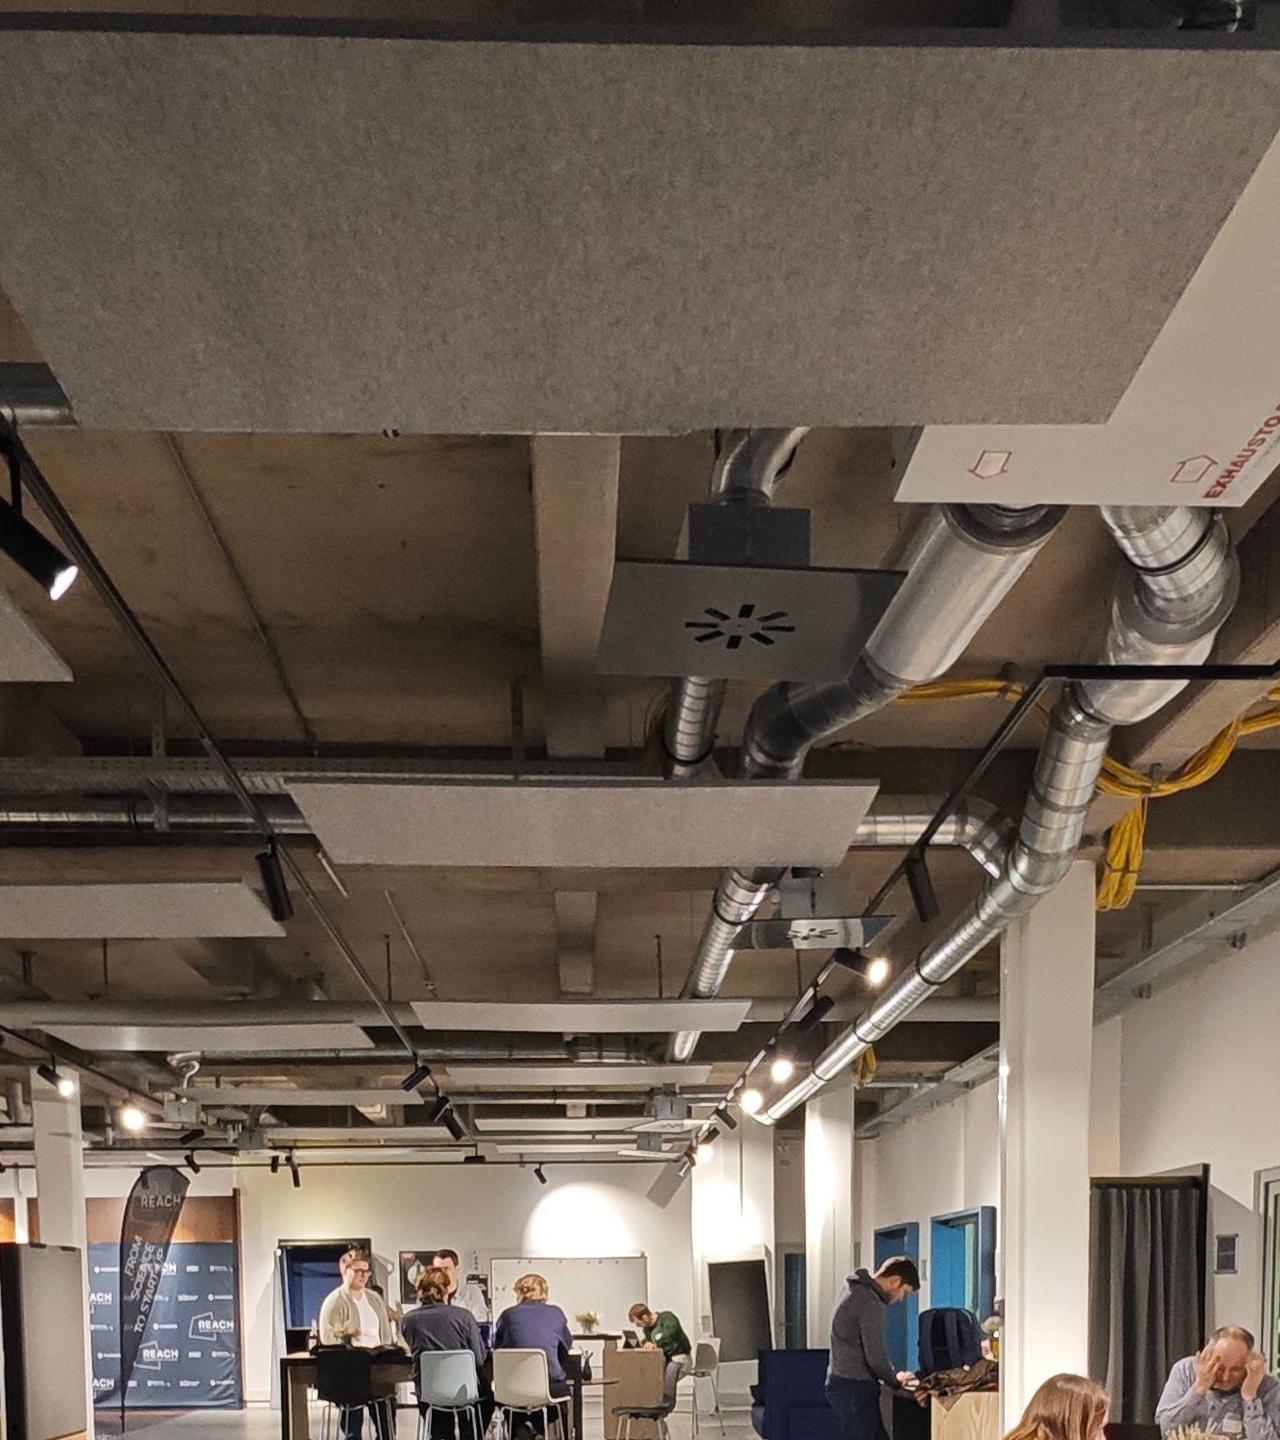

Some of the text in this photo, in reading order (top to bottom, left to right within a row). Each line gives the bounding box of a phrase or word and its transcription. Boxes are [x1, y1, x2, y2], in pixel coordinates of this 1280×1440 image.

[140, 1194, 181, 1209] REACH
[124, 1234, 143, 1277] FROM
[89, 1291, 113, 1302] ACH
[134, 1314, 146, 1333] TO
[198, 1320, 234, 1331] REACH
[142, 1348, 179, 1360] REACH
[92, 1377, 115, 1388] ACH
